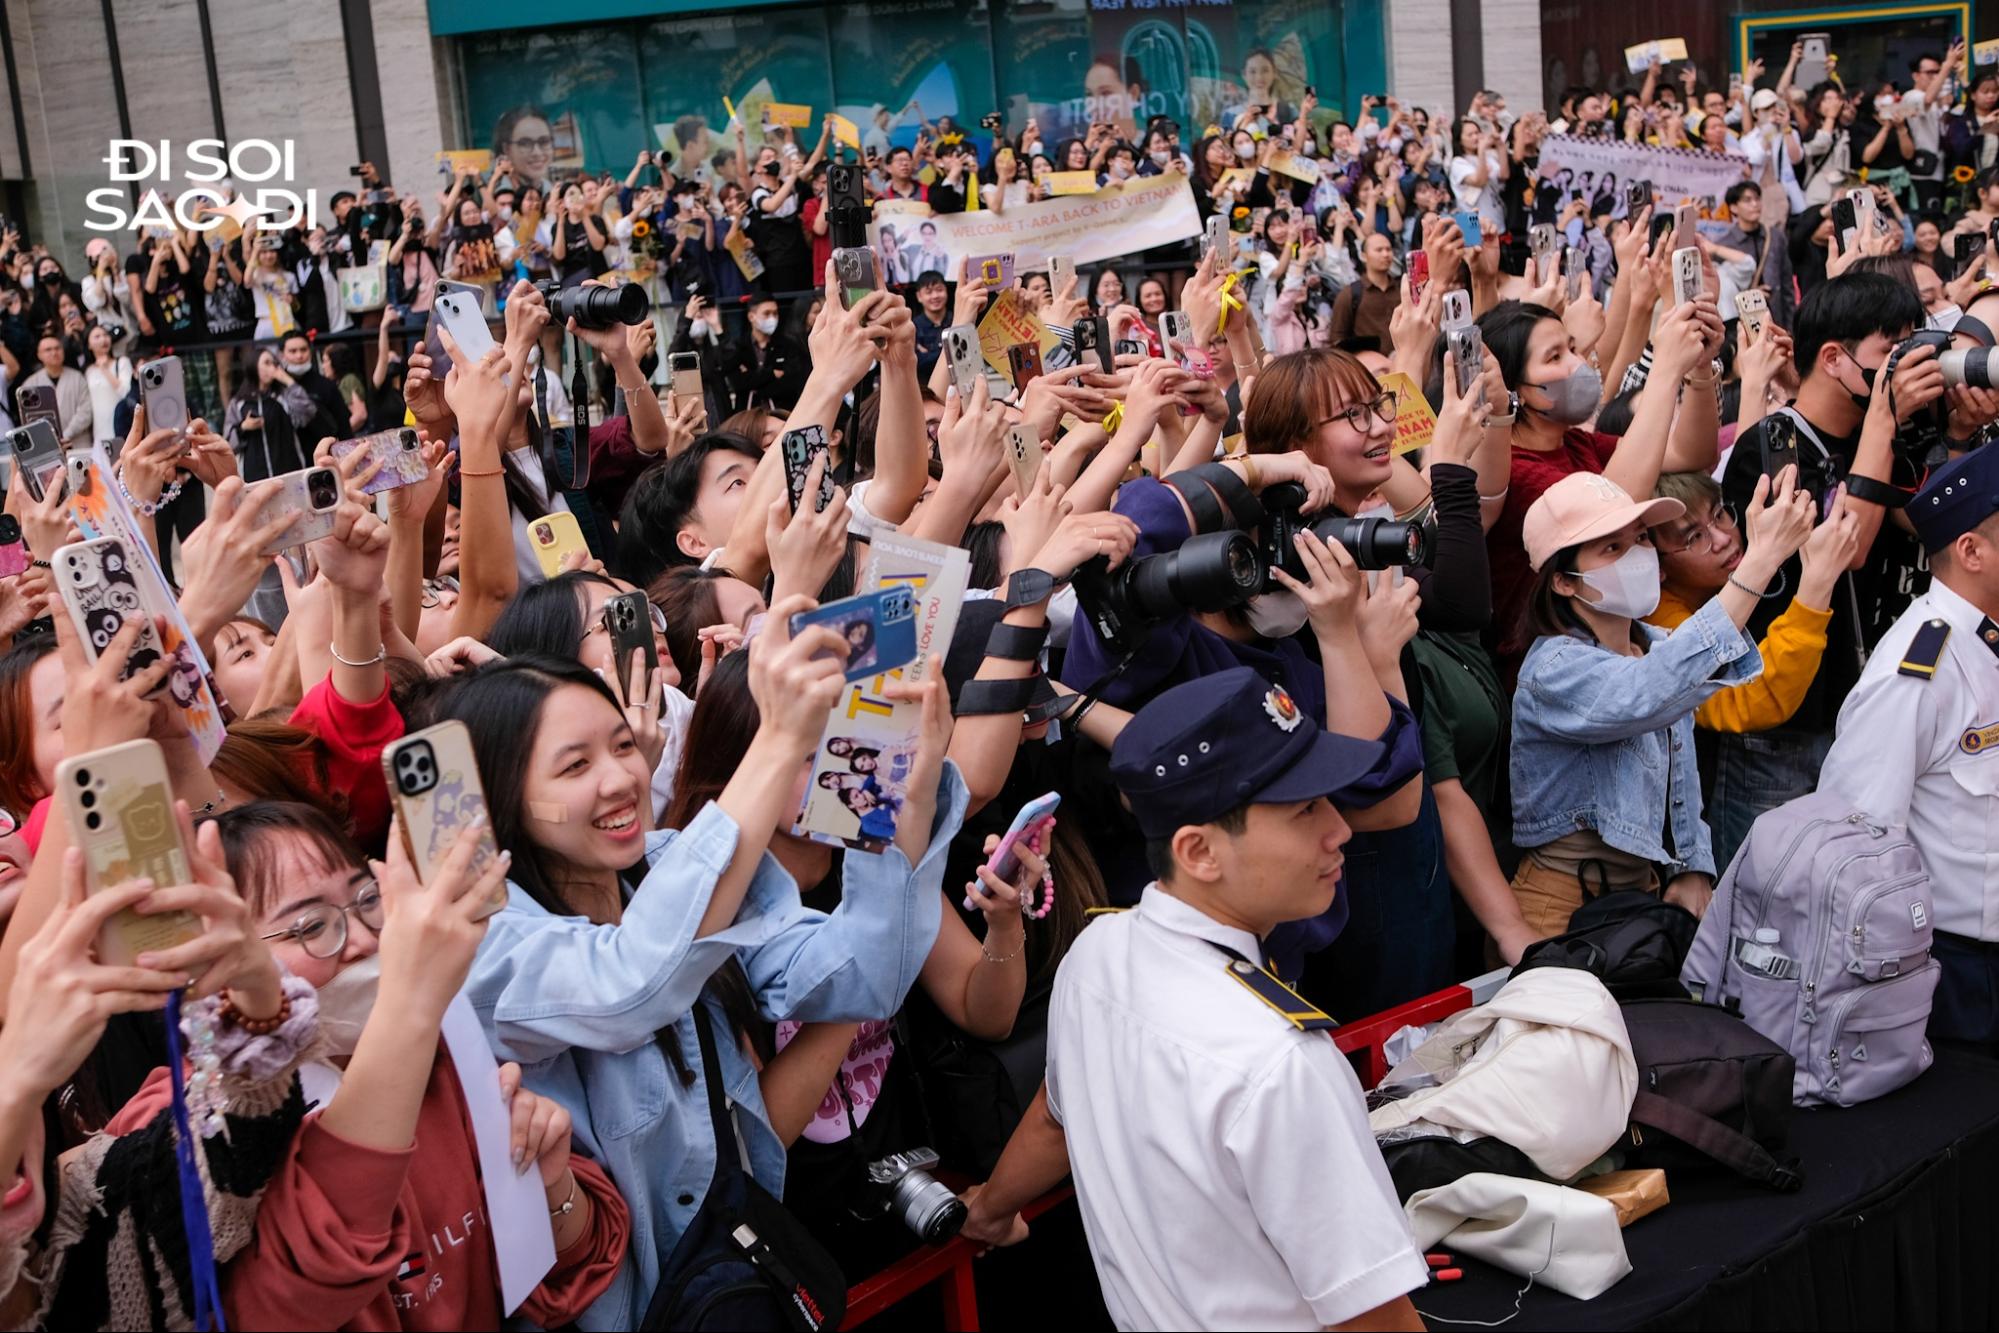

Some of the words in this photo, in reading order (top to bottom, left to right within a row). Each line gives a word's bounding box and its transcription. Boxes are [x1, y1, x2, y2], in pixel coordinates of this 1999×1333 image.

[953, 221, 1013, 237] WELCOME
[1063, 203, 1099, 222] BACK
[1102, 199, 1121, 211] TO
[577, 404, 586, 425] EOS
[927, 596, 941, 620] YOU
[920, 622, 935, 650] LOVE
